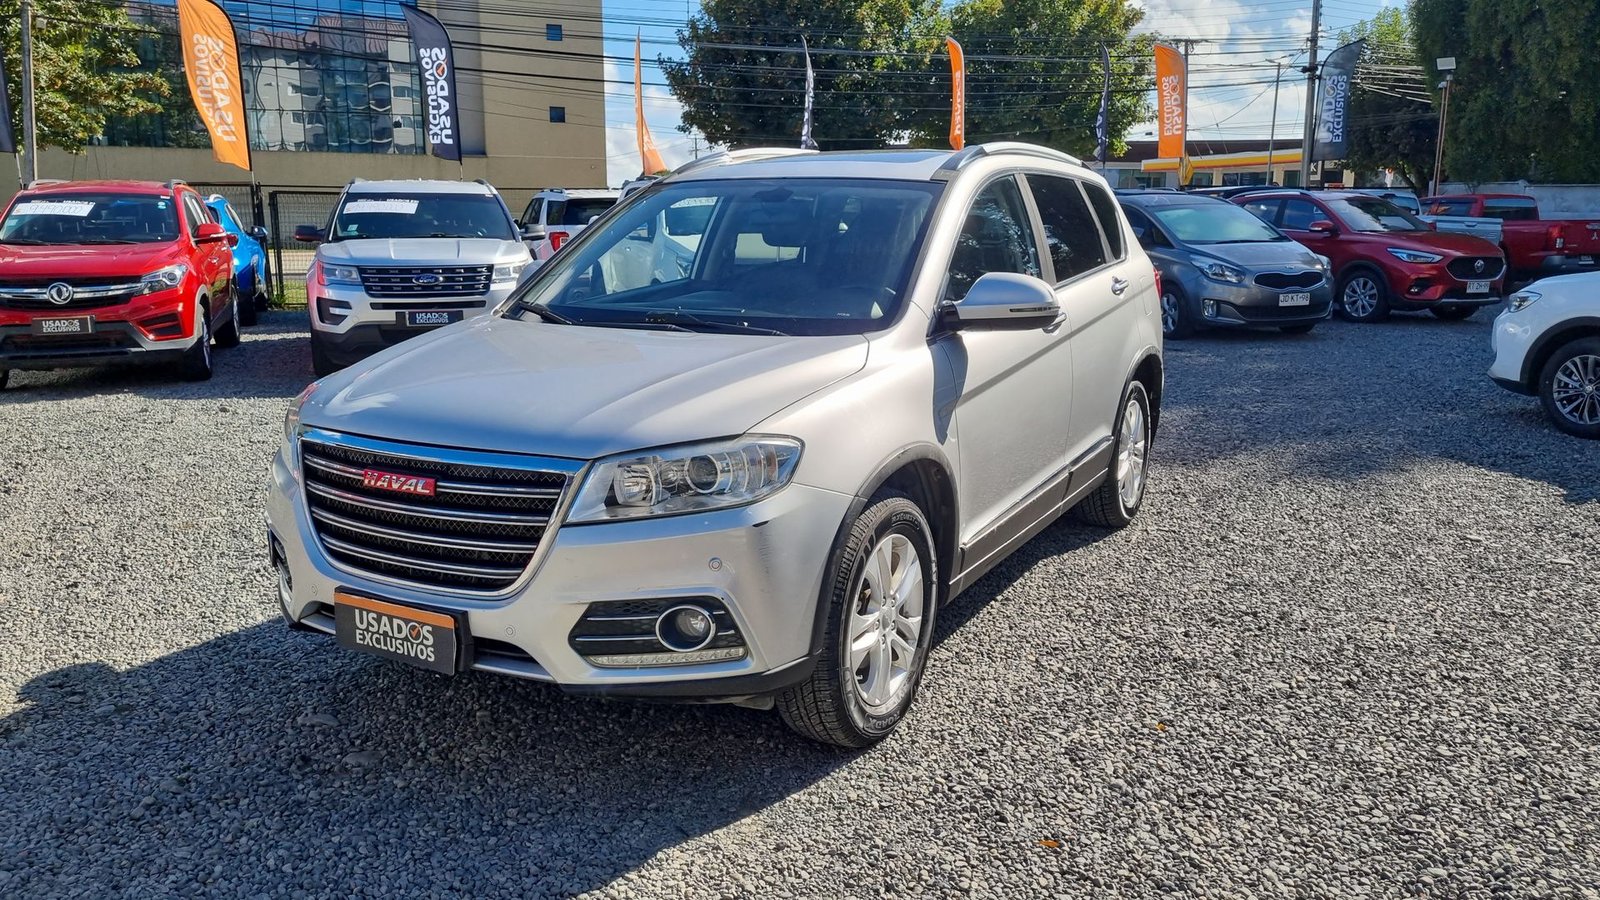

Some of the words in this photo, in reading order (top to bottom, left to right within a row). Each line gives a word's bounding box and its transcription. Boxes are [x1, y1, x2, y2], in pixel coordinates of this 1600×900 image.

[1320, 75, 1338, 143] USADOS
[1333, 75, 1347, 143] EXCLUSIVOS
[42, 319, 80, 328] USADOS
[364, 471, 430, 493] HAVAL
[354, 608, 434, 646] USADOS
[355, 629, 435, 662] EXCLUSIVOS
